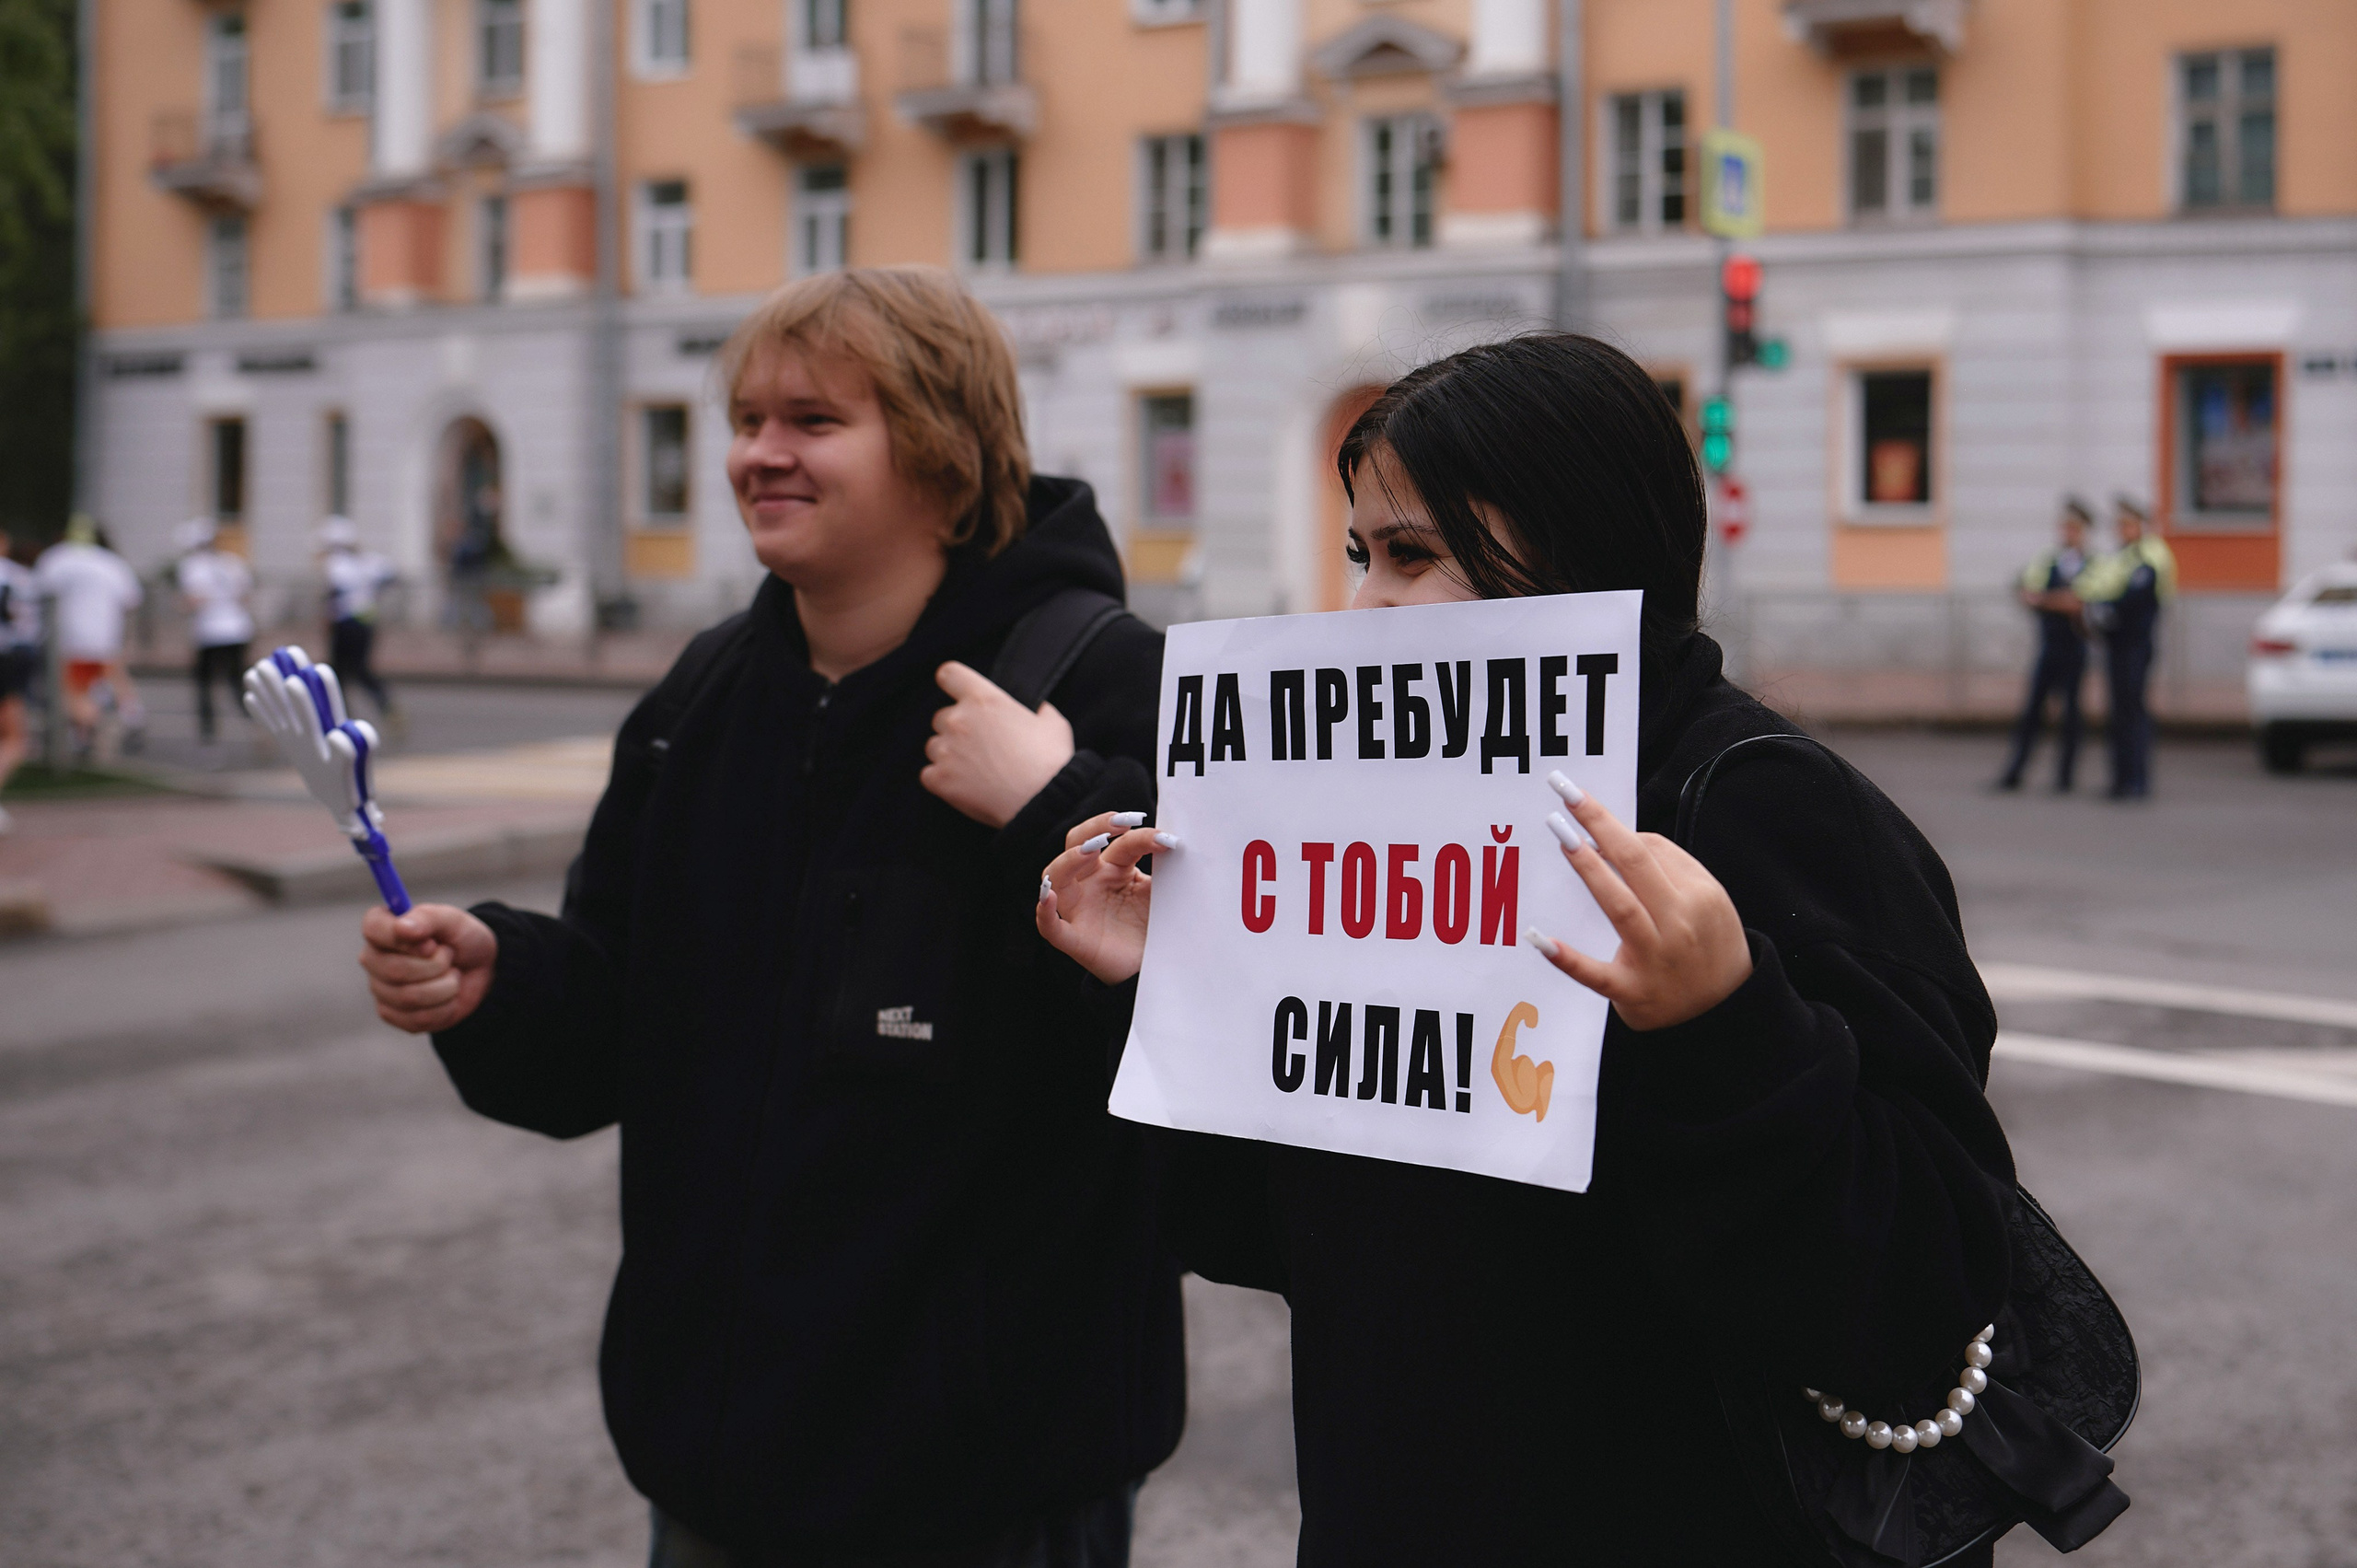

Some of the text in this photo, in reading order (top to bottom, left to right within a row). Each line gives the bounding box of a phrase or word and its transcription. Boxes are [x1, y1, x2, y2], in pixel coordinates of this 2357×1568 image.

[1167, 653, 1619, 777] ДА ПРЕБУДЕТ
[1241, 824, 1519, 947] С ТОБОЙ
[877, 1005, 913, 1022] NEXT
[877, 1021, 934, 1041] STATION
[1271, 995, 1475, 1113] СИЛА!
